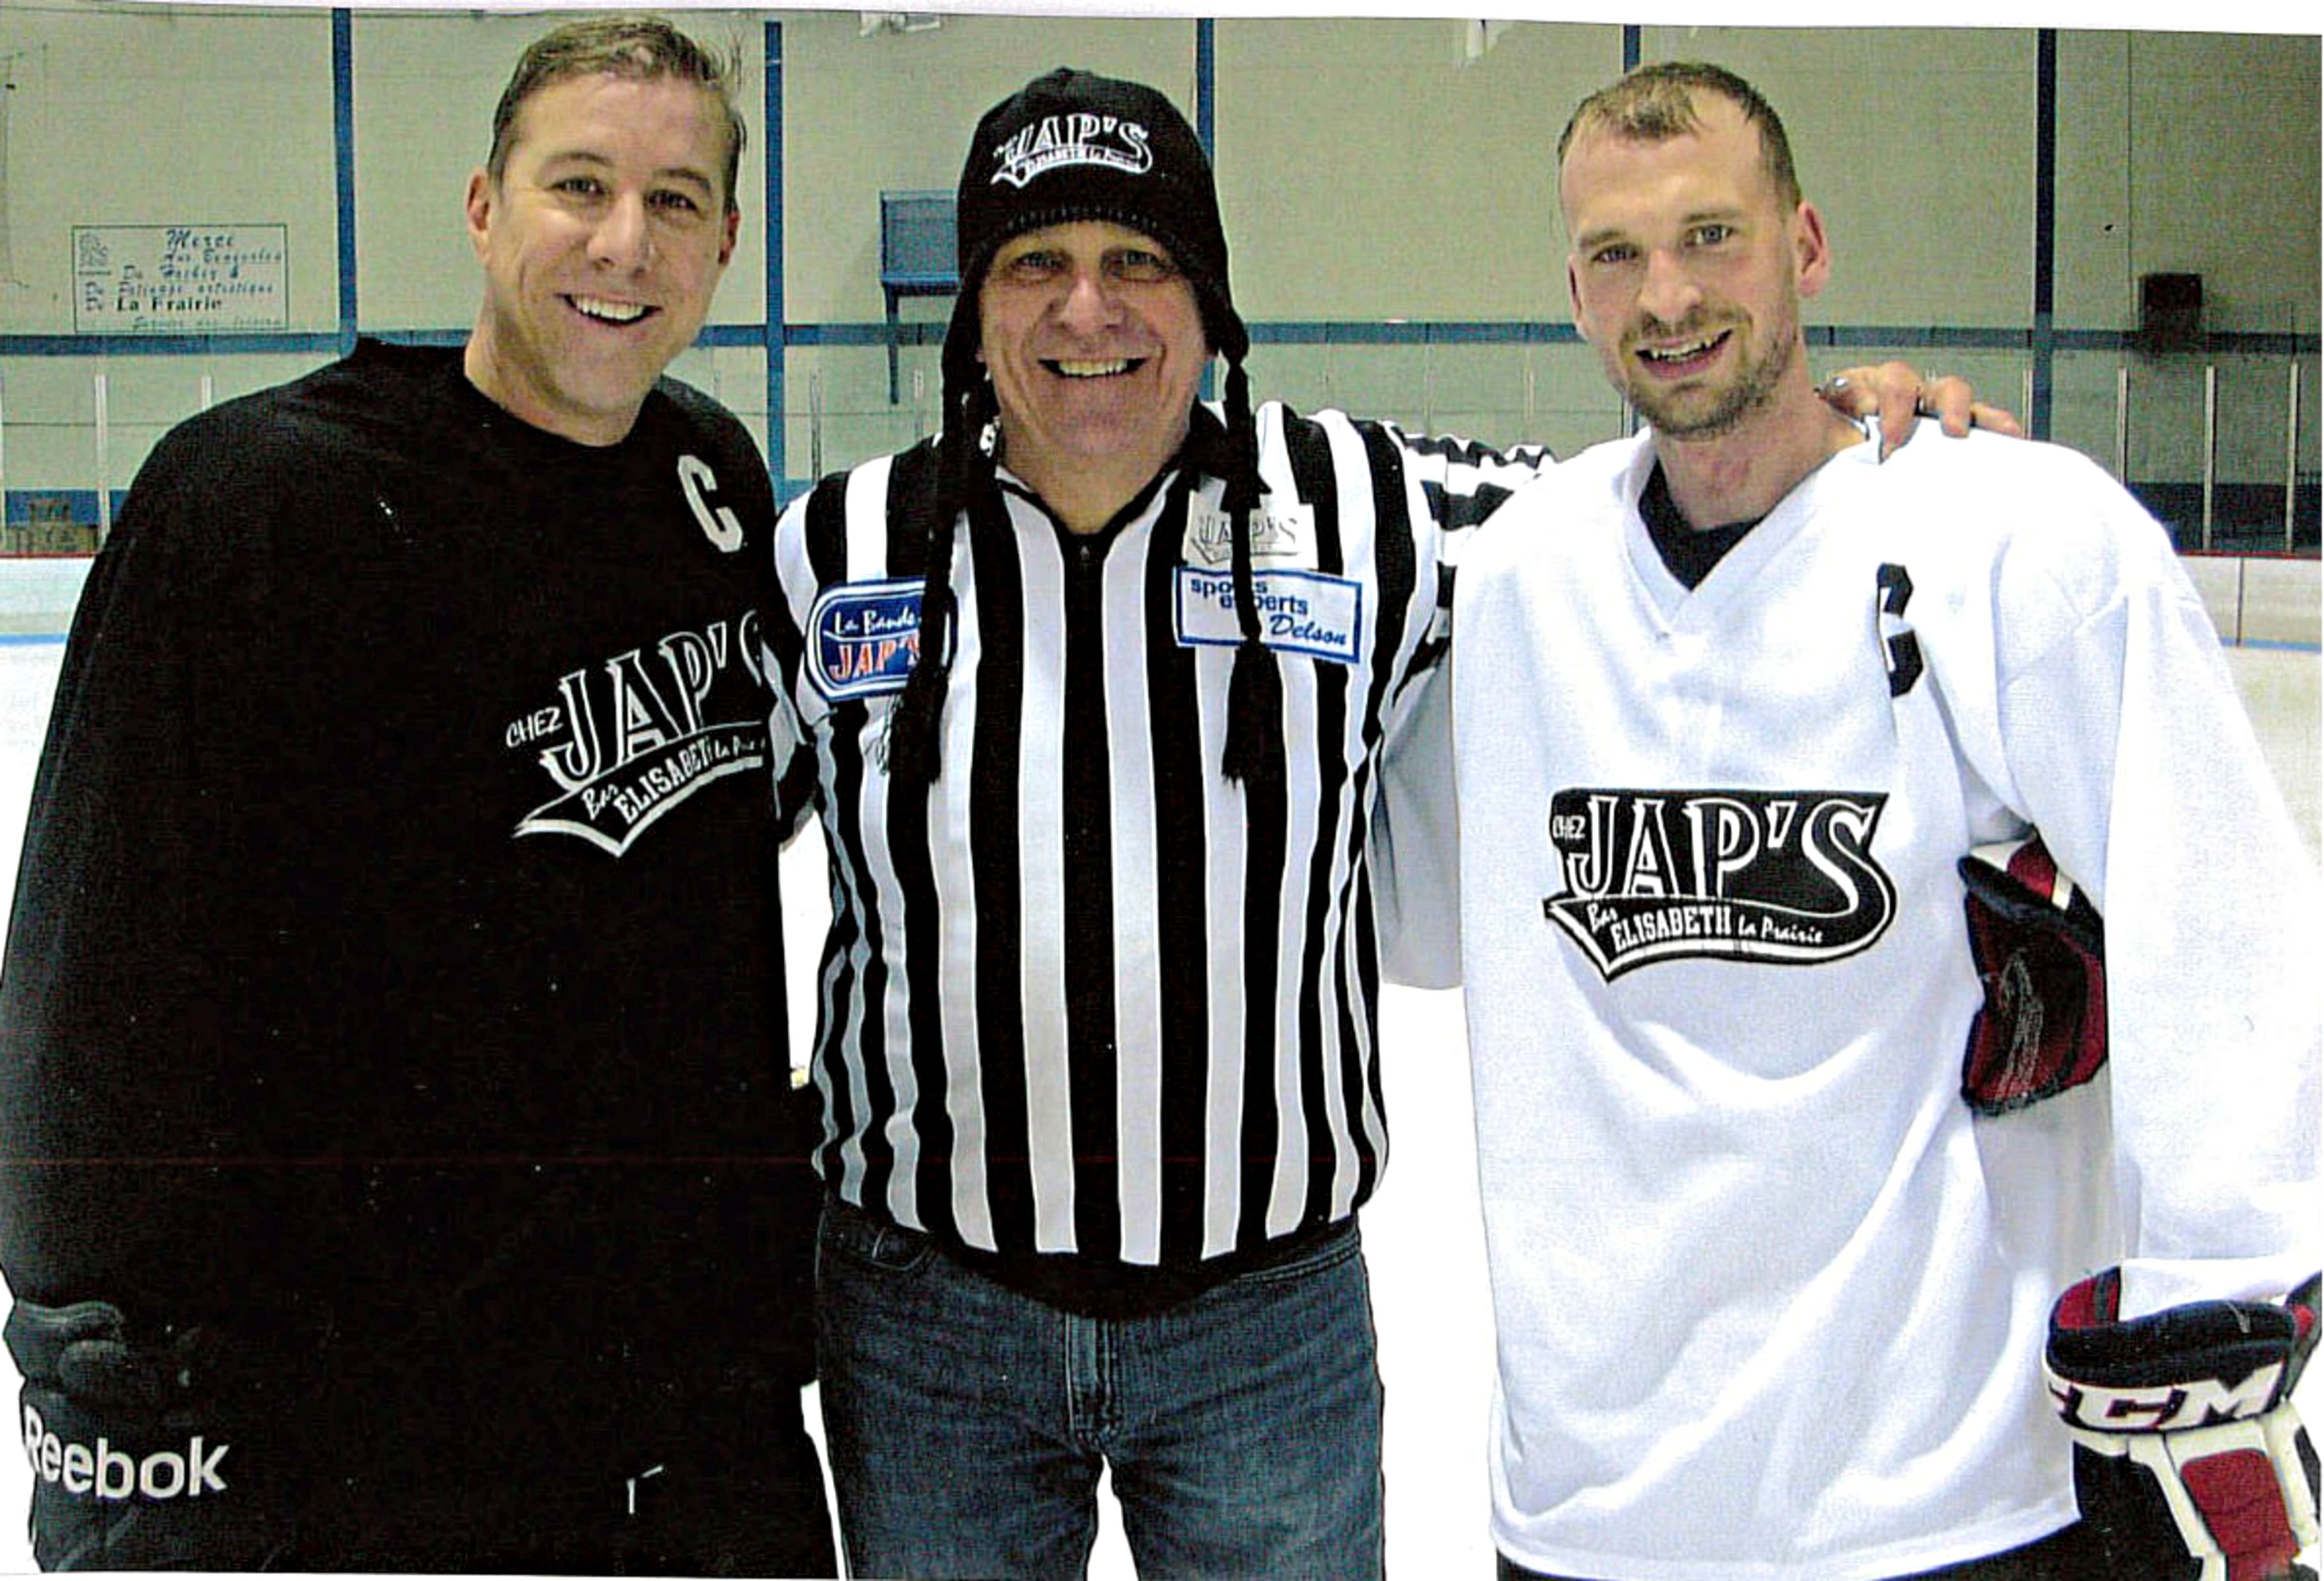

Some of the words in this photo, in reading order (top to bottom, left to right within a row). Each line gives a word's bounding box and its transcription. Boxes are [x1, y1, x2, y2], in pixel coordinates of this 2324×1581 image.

[1005, 112, 1153, 173] JAP'S
[117, 297, 139, 312] La
[677, 455, 743, 552] C
[1190, 579, 1268, 599] spos
[1220, 595, 1308, 615] eperts
[834, 610, 860, 635] La
[1270, 614, 1346, 645] Delson
[506, 706, 563, 747] CHEZ
[1565, 793, 1892, 920] JAP'S
[1586, 902, 1618, 934] Bar
[1609, 905, 1732, 954] ELISABETH
[1761, 915, 1823, 944] Prairie
[2044, 1363, 2285, 1430] CCM
[24, 1403, 231, 1500] Reebok
